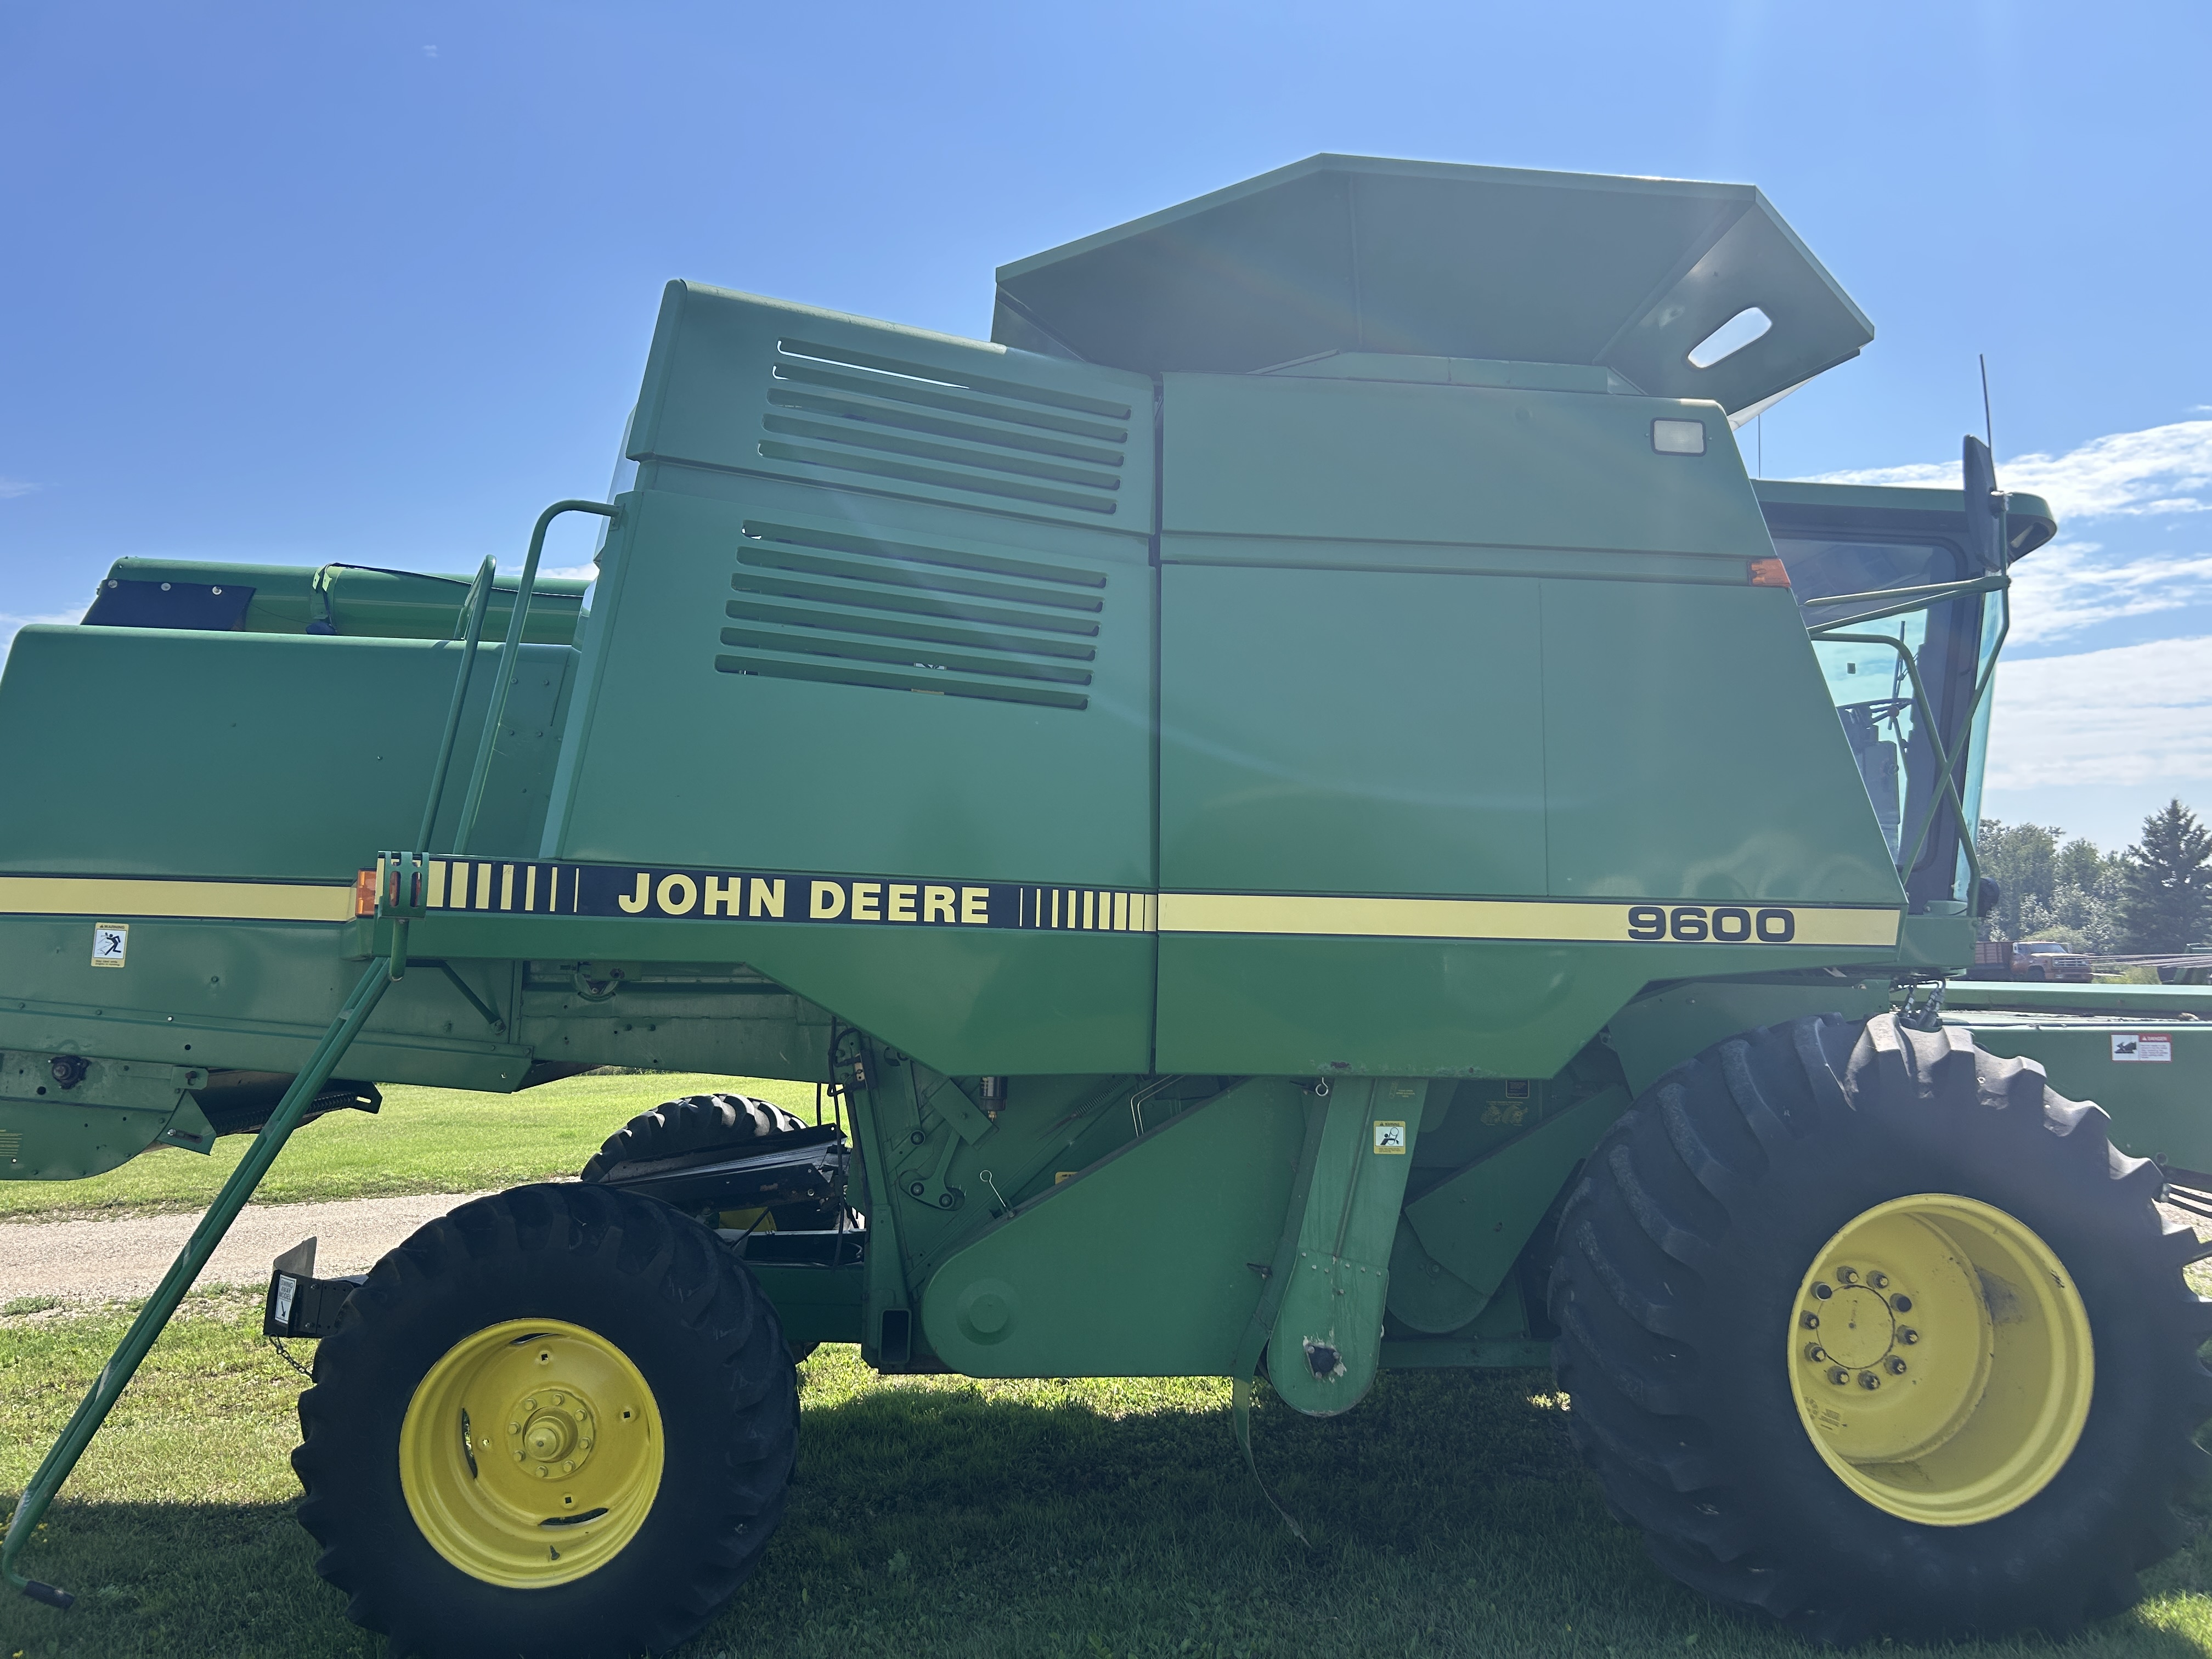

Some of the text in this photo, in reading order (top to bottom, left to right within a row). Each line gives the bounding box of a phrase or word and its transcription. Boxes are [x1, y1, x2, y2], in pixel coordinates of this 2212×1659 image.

[619, 873, 990, 924] JOHN DEERE
[1628, 906, 1795, 943] 9600
[281, 1279, 293, 1289] SWING
[280, 1286, 292, 1294] AWAY
[279, 1292, 292, 1301] MODEL
